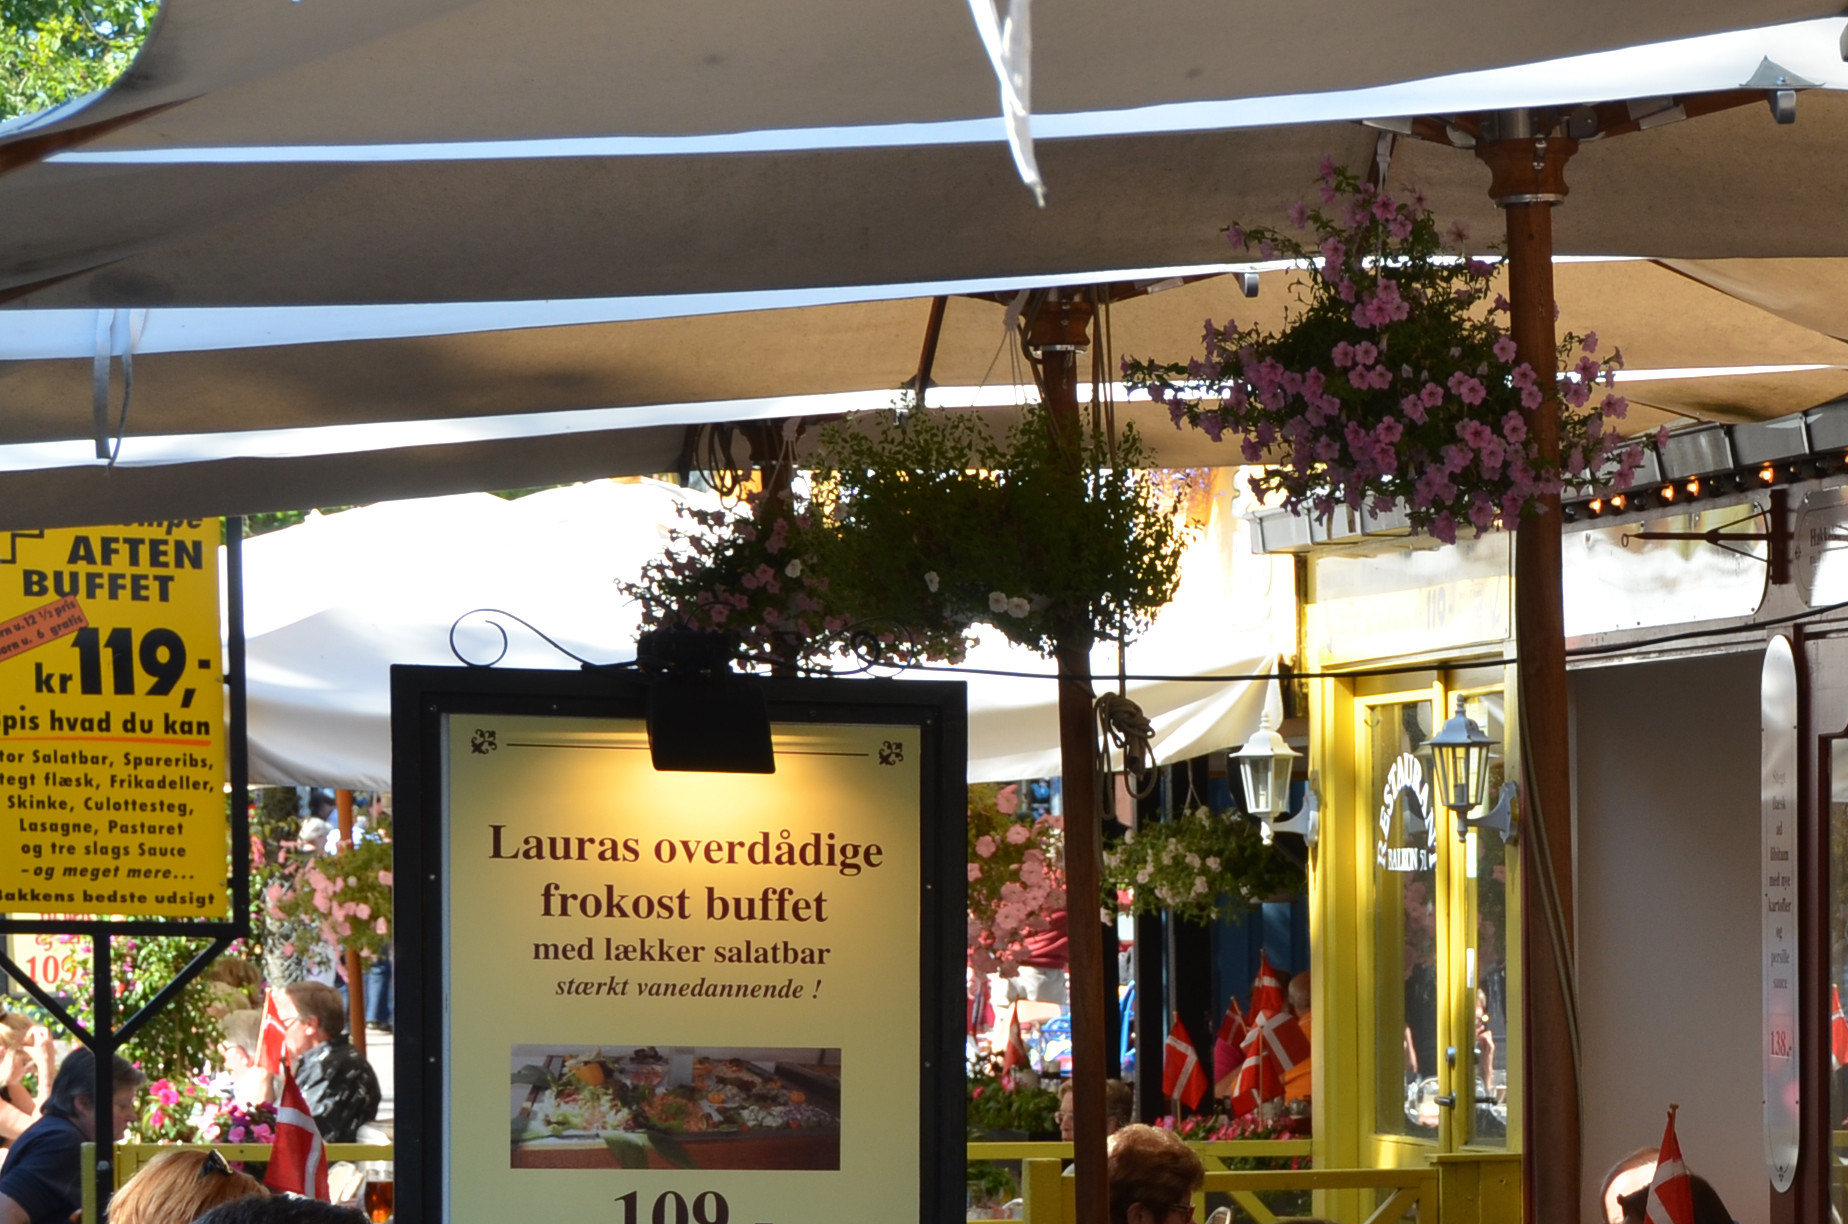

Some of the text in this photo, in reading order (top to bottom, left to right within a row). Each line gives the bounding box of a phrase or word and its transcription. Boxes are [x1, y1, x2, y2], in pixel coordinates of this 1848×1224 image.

[67, 535, 203, 570] AFTEN
[22, 568, 175, 603] BUFFET
[54, 600, 77, 618] pris
[37, 628, 45, 639] 6
[50, 615, 83, 637] gratis
[34, 627, 211, 709] kr 119,-
[0, 705, 211, 736] pis hvad du kan
[32, 749, 114, 768] Salatbar,
[123, 752, 214, 771] Spareribs,
[44, 771, 101, 791] flæsk,
[110, 774, 215, 794] Frikadeller,
[7, 794, 194, 817] Skinke, Culottesteg,
[19, 818, 184, 837] Lasagne, Pastaret
[21, 841, 187, 860] og tre slags Sauce
[488, 824, 884, 877] Lauras overdådige
[62, 865, 120, 882] meget
[83, 889, 148, 904] bedste
[154, 891, 216, 909] udsigt
[540, 882, 829, 923] frokost buffet
[532, 937, 832, 965] med lækker salatbar
[555, 975, 823, 999] stærkt vanedannende !
